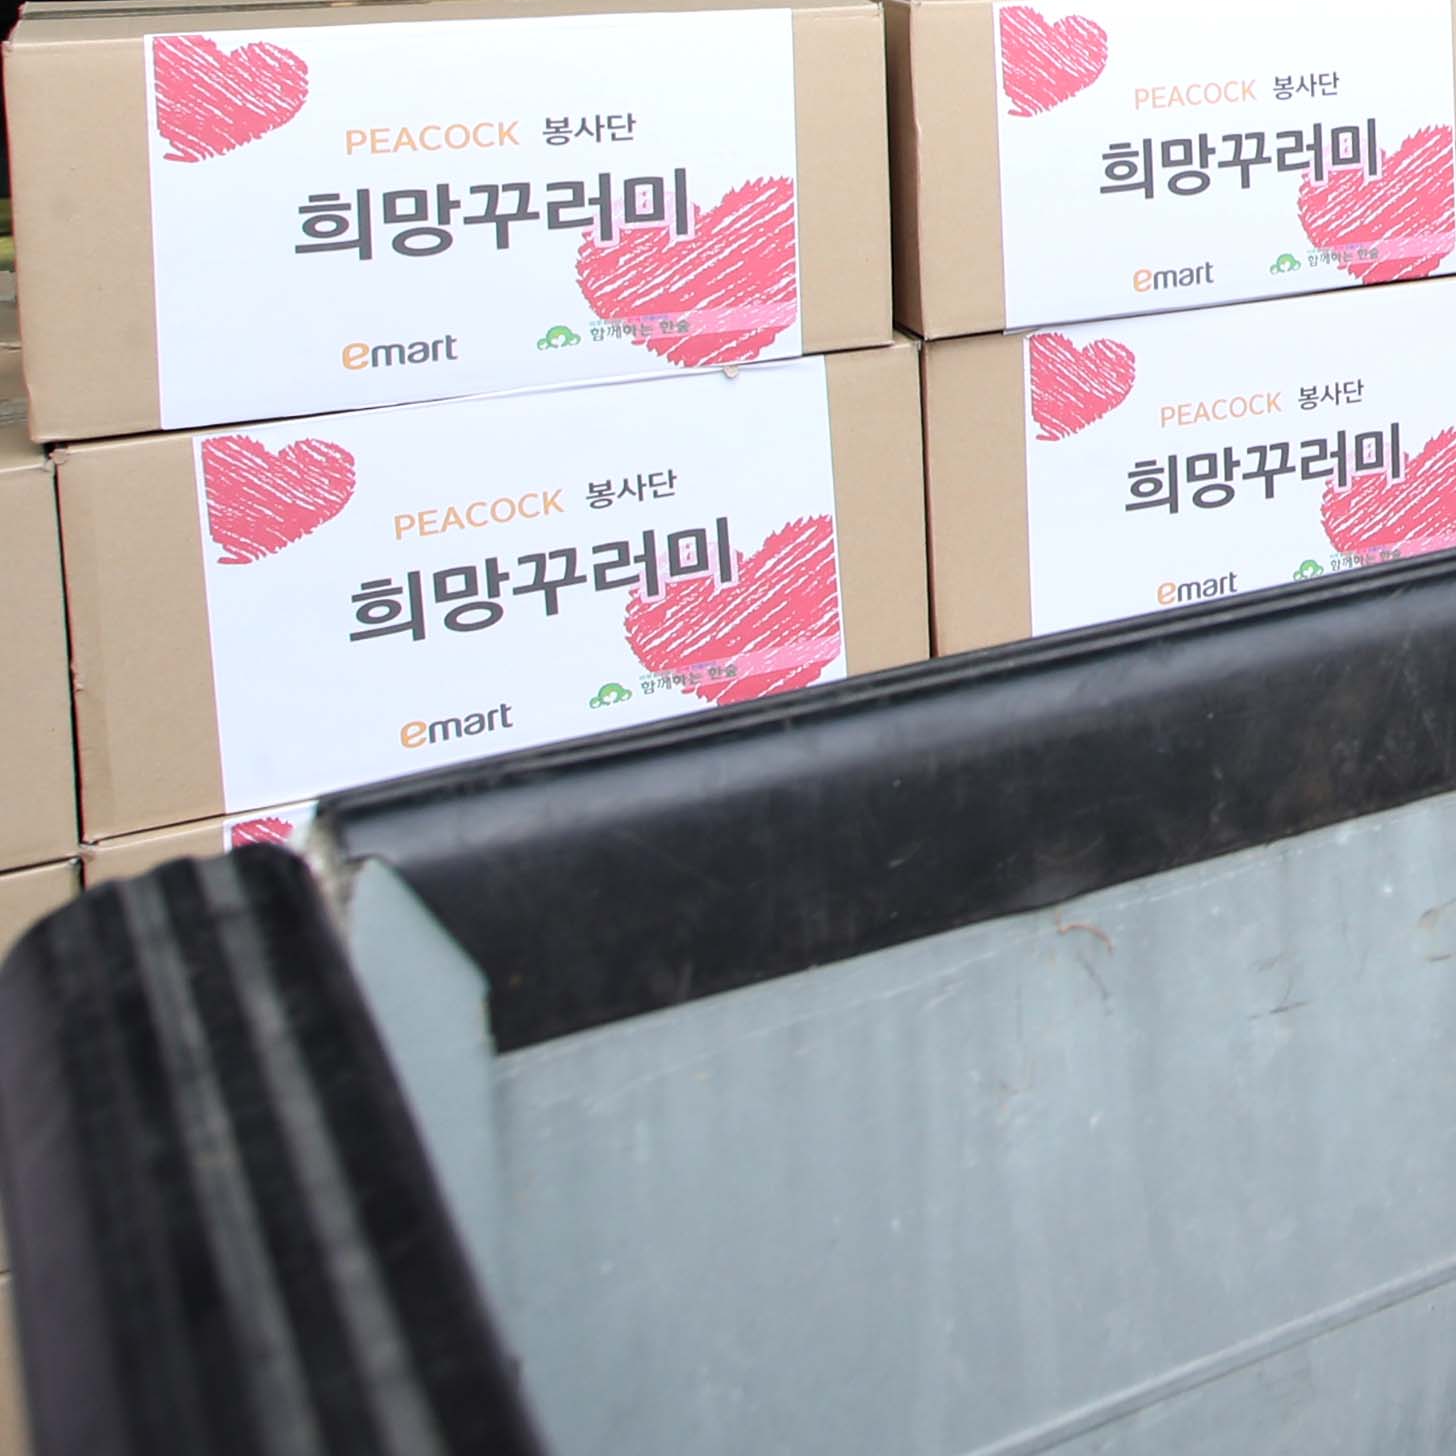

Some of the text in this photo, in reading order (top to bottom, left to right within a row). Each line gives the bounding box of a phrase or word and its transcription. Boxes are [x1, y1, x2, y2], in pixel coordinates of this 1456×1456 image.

[1133, 70, 1340, 111] PEACOCK 봉사단
[343, 112, 637, 157] PEACOCK 봉사단
[1099, 117, 1379, 200] 희망꾸러미
[293, 166, 690, 262] 희망꾸러미
[1132, 260, 1215, 294] emart
[340, 332, 459, 371] emart
[1159, 377, 1365, 429] PEACOCK 봉사단
[1124, 421, 1405, 516] 희망꾸러미
[393, 468, 678, 541] PEACOCK 봉사단
[347, 515, 735, 644] 희망꾸러미
[1156, 570, 1239, 607] emart
[399, 699, 514, 750] emart
